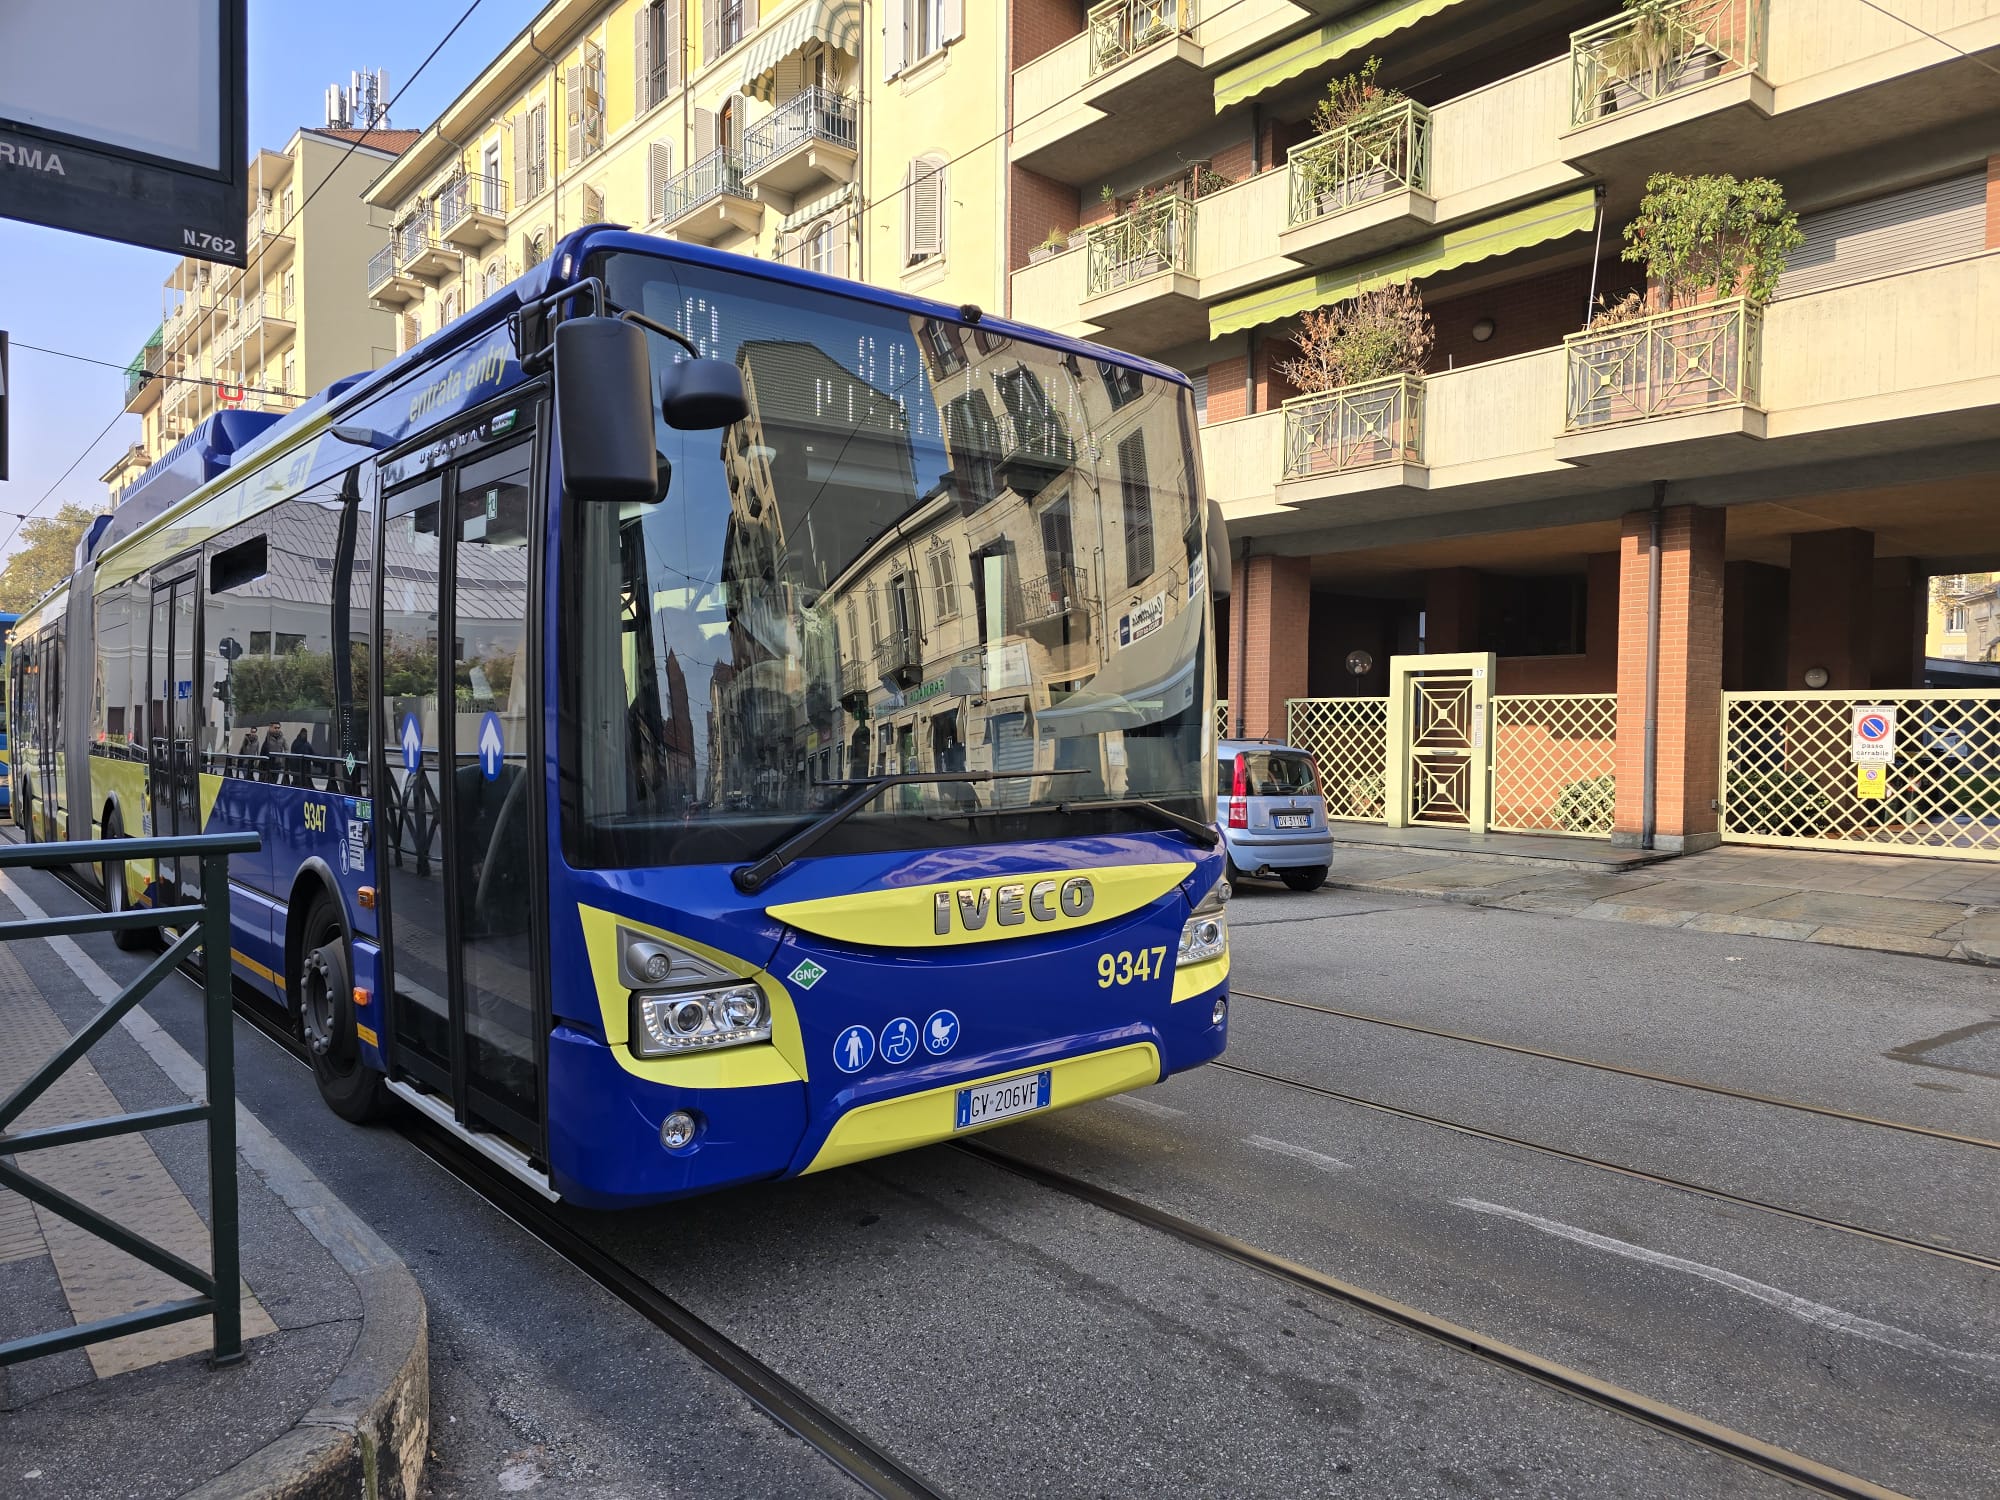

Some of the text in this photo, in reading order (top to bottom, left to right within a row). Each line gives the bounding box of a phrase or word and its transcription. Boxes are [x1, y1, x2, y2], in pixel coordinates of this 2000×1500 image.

[183, 229, 236, 255] N.762
[409, 370, 462, 422] entrata
[465, 343, 510, 391] entry
[419, 424, 487, 465] URBANWAY
[304, 801, 327, 833] 9347
[934, 877, 1095, 935] IVECO
[794, 967, 820, 981] GNC
[1097, 946, 1167, 989] 9347
[971, 1093, 989, 1117] GV
[995, 1081, 1038, 1112] 206VF
